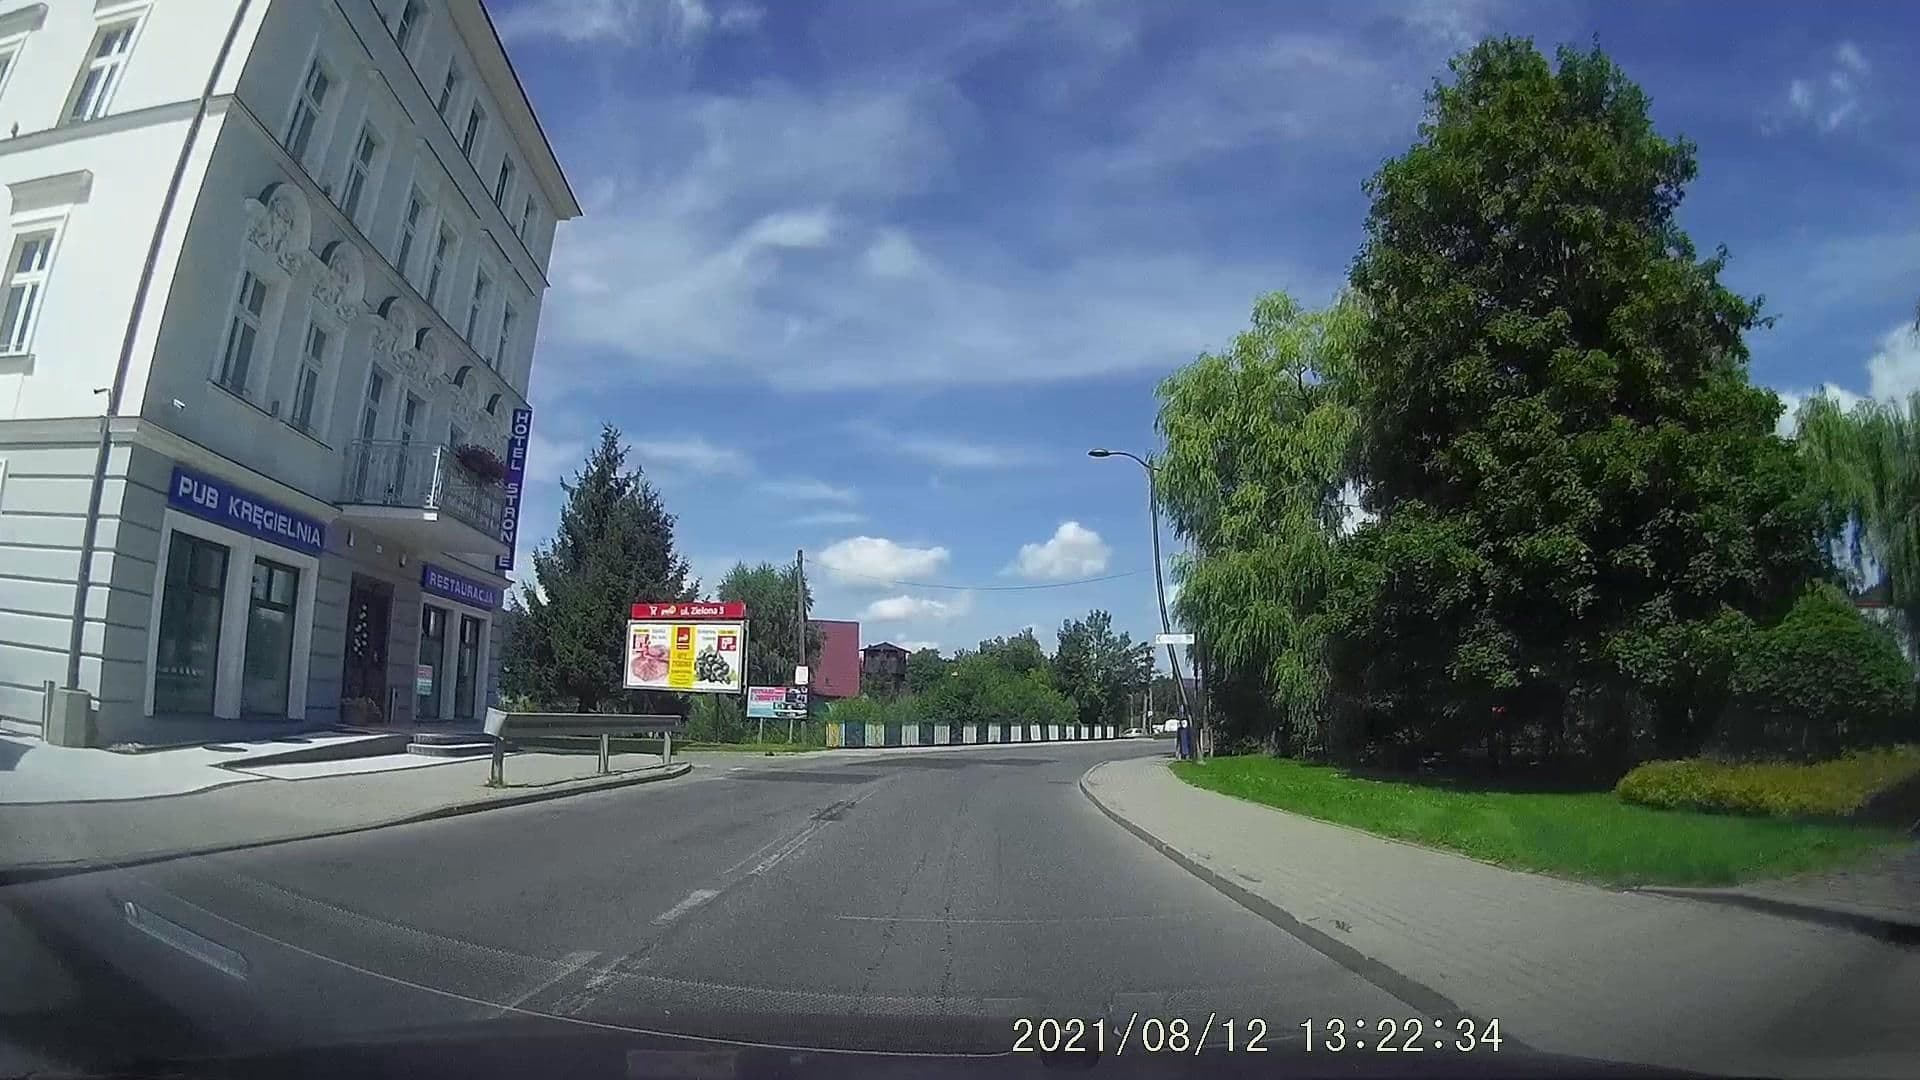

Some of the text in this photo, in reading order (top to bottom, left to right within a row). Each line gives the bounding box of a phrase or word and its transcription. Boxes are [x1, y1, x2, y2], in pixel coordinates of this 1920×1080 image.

[178, 475, 321, 548] PUB KRĘGIELNIA
[499, 412, 528, 567] HOTEL STRONE
[430, 572, 494, 604] RESTAURACJA
[691, 606, 718, 616] Zielona
